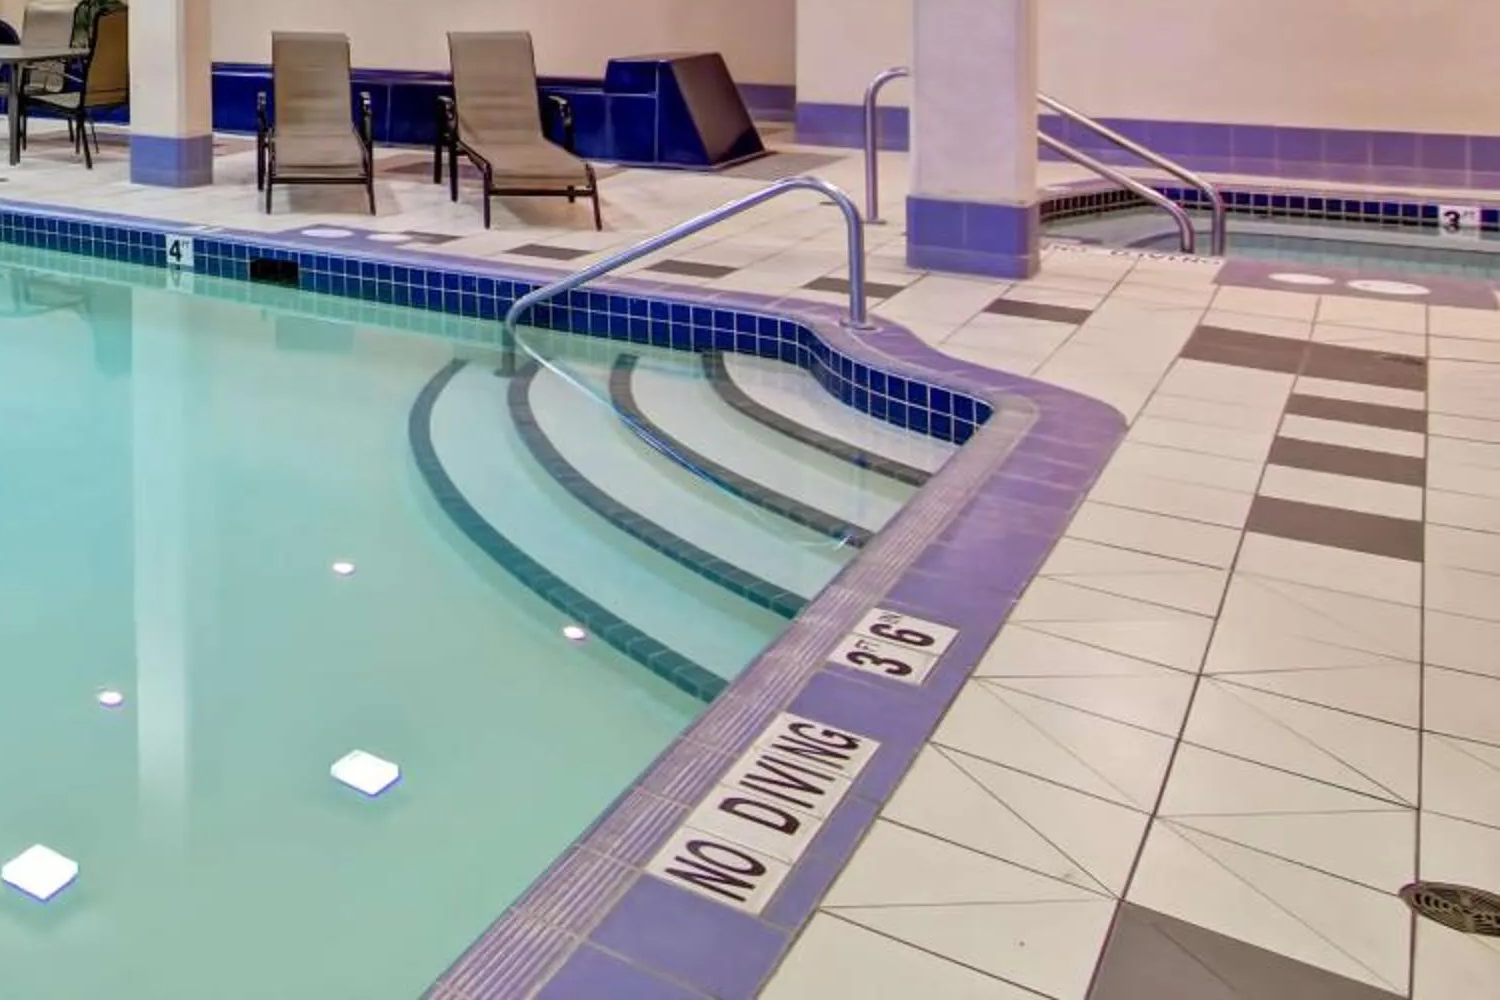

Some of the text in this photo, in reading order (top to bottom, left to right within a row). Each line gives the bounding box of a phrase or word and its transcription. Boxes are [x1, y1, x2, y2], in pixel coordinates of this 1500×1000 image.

[1444, 211, 1460, 226] 3
[169, 240, 181, 262] 4
[869, 623, 935, 647] 6
[846, 651, 913, 676] 3
[665, 722, 860, 902] NO DIVING
